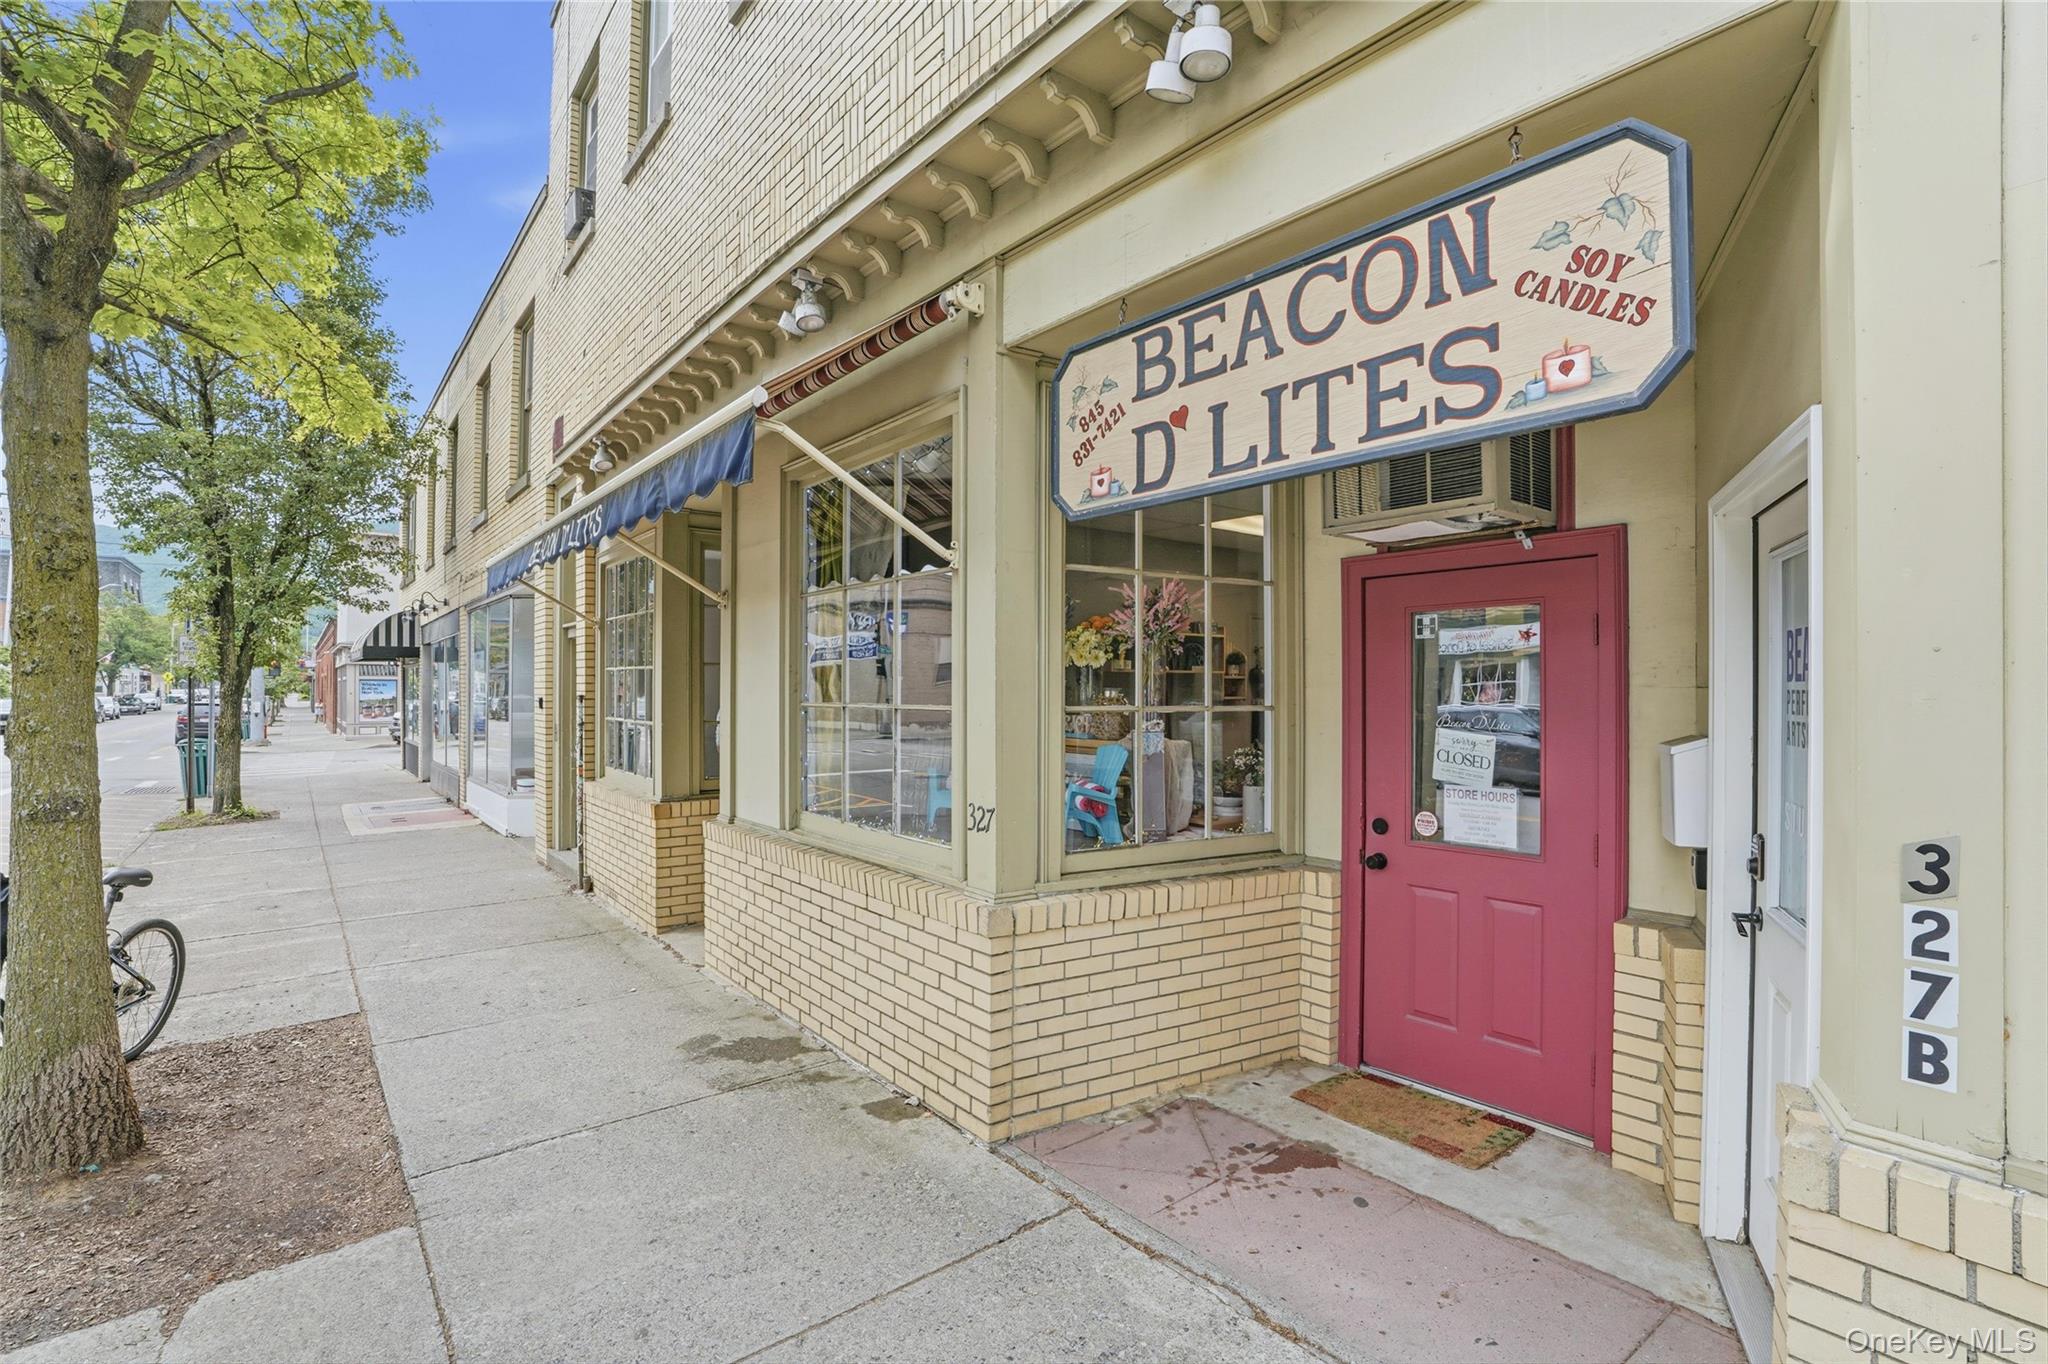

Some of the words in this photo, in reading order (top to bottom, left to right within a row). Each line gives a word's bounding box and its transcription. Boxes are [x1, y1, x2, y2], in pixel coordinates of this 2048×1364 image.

[1564, 244, 1635, 283] SOY
[1131, 196, 1498, 403] BEACON
[1513, 269, 1658, 327] CANDLES
[1079, 399, 1105, 433] 845
[1072, 402, 1127, 467] 831-7421
[1436, 748, 1491, 770] CLOSED
[1445, 788, 1478, 801] STORE
[1480, 791, 1516, 804] HOURS
[967, 802, 996, 833] 327
